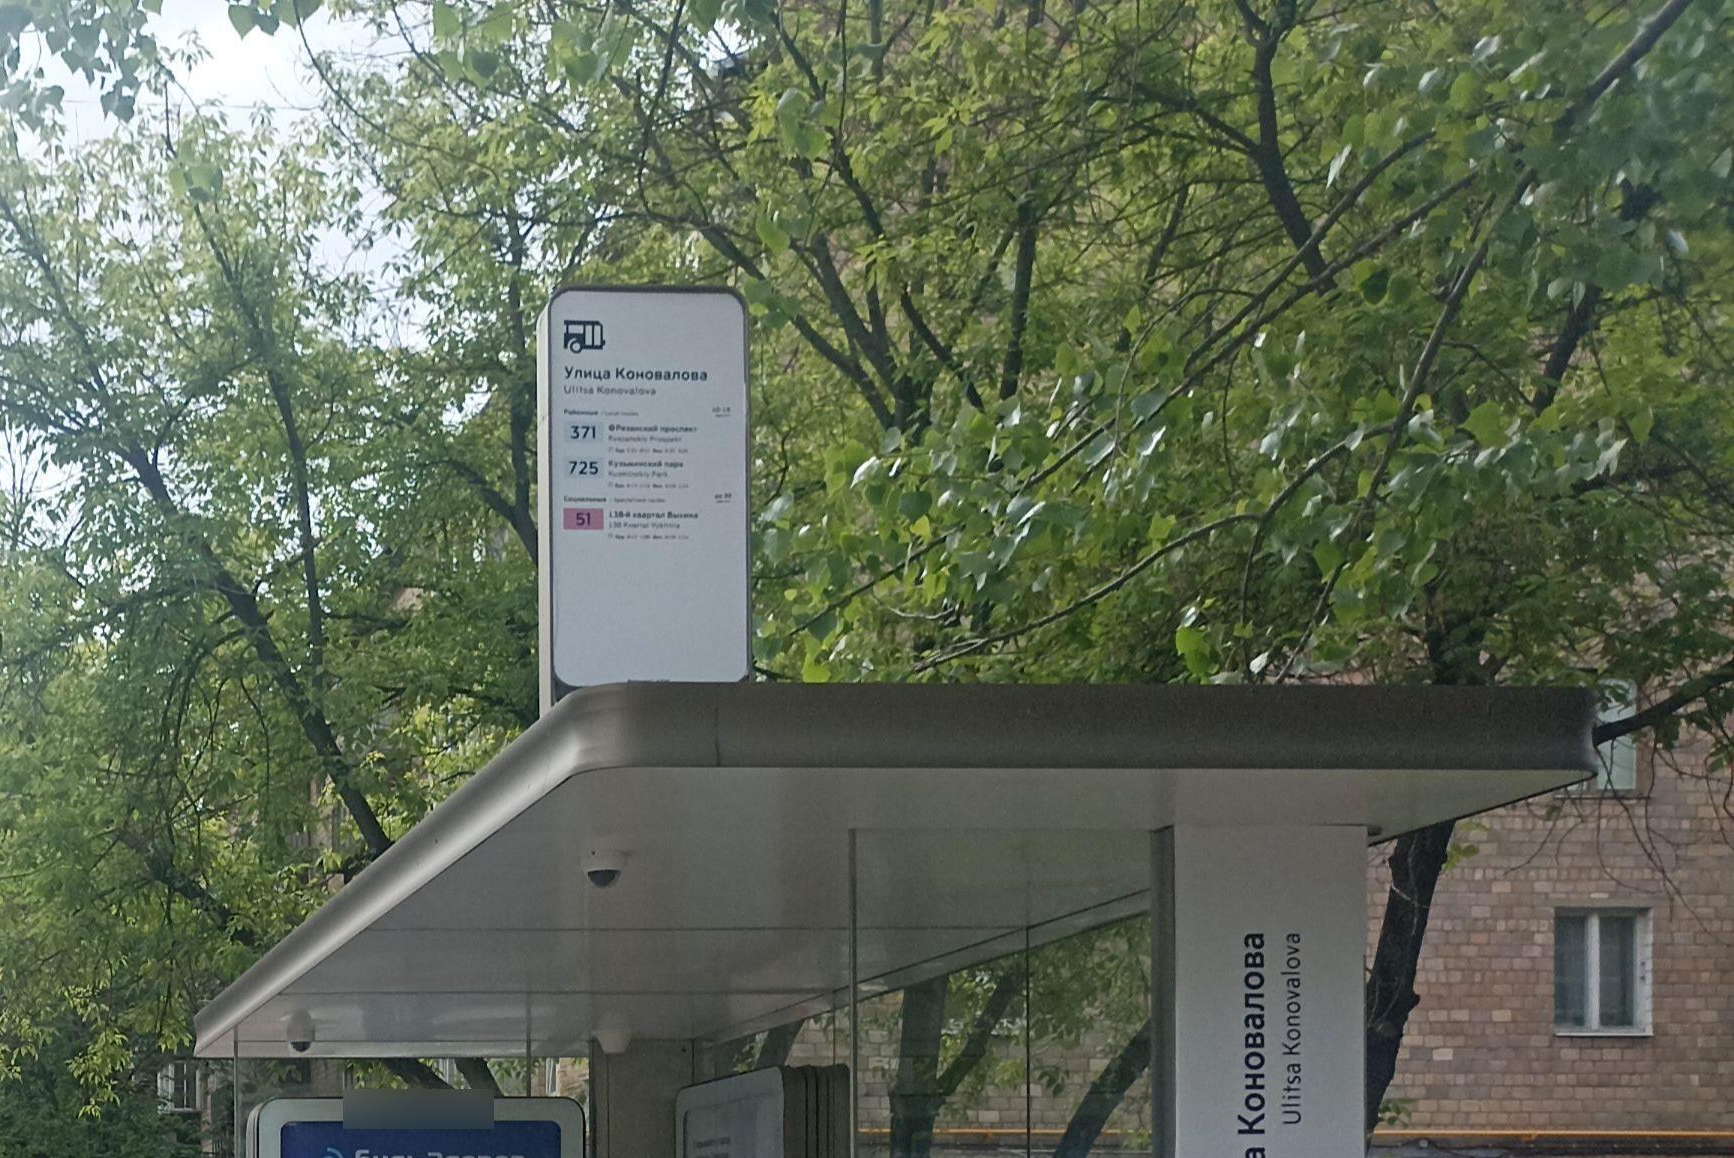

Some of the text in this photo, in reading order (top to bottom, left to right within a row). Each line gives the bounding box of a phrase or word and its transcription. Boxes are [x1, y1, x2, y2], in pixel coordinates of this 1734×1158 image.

[564, 366, 708, 381] Улица Коновалова
[597, 385, 657, 396] Konovalova
[570, 425, 597, 440] 371
[569, 461, 599, 475] 725
[575, 512, 592, 526] 51
[1237, 933, 1266, 1135] Коновалова
[1281, 933, 1301, 1125] Ulitsa Konovalova
